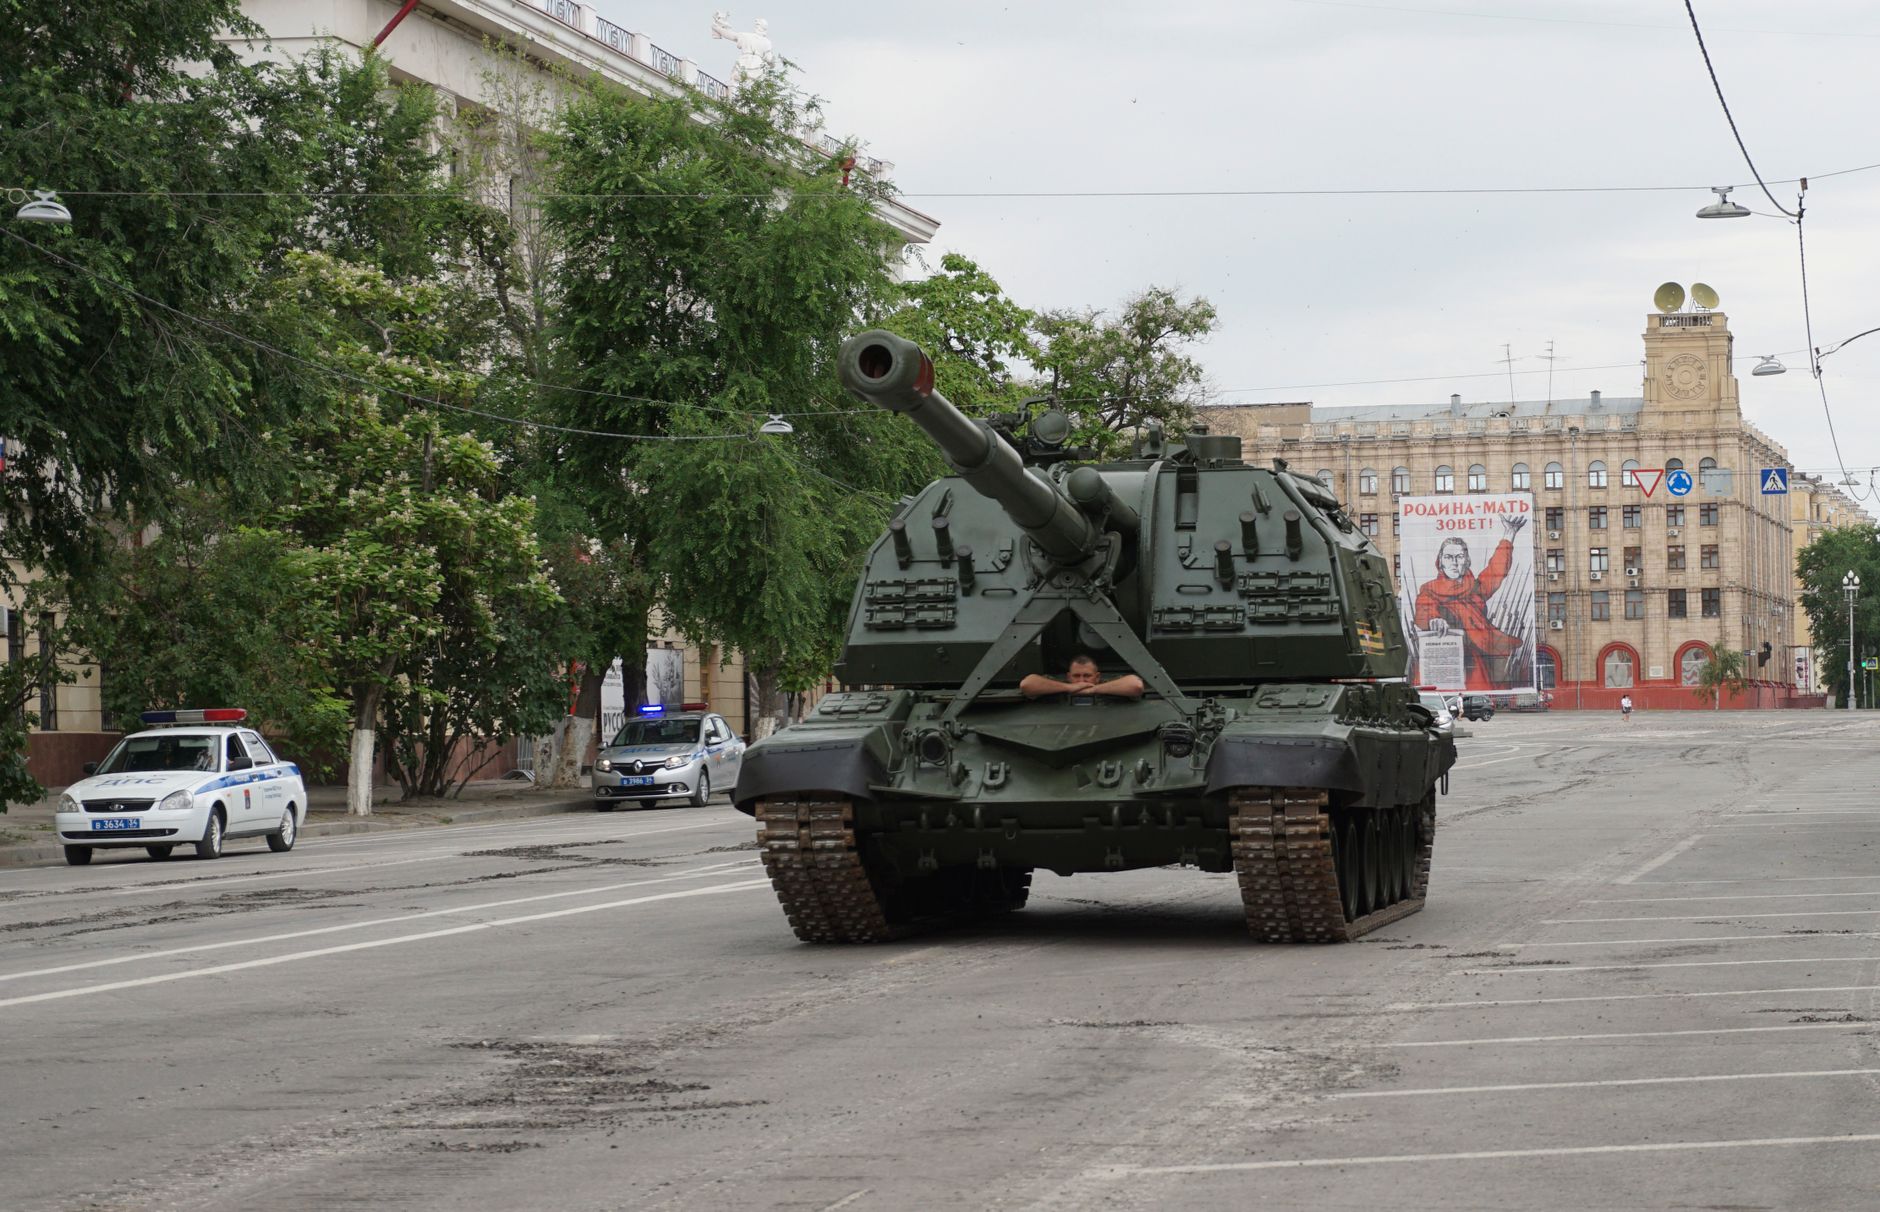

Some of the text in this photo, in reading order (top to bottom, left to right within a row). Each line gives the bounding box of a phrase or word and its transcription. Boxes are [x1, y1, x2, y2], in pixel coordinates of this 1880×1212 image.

[1403, 500, 1529, 516] РОДИНА-МАТЬ
[1436, 518, 1493, 531] ЗОВЕТ!
[95, 778, 167, 788] ДПС
[103, 819, 125, 829] 3634
